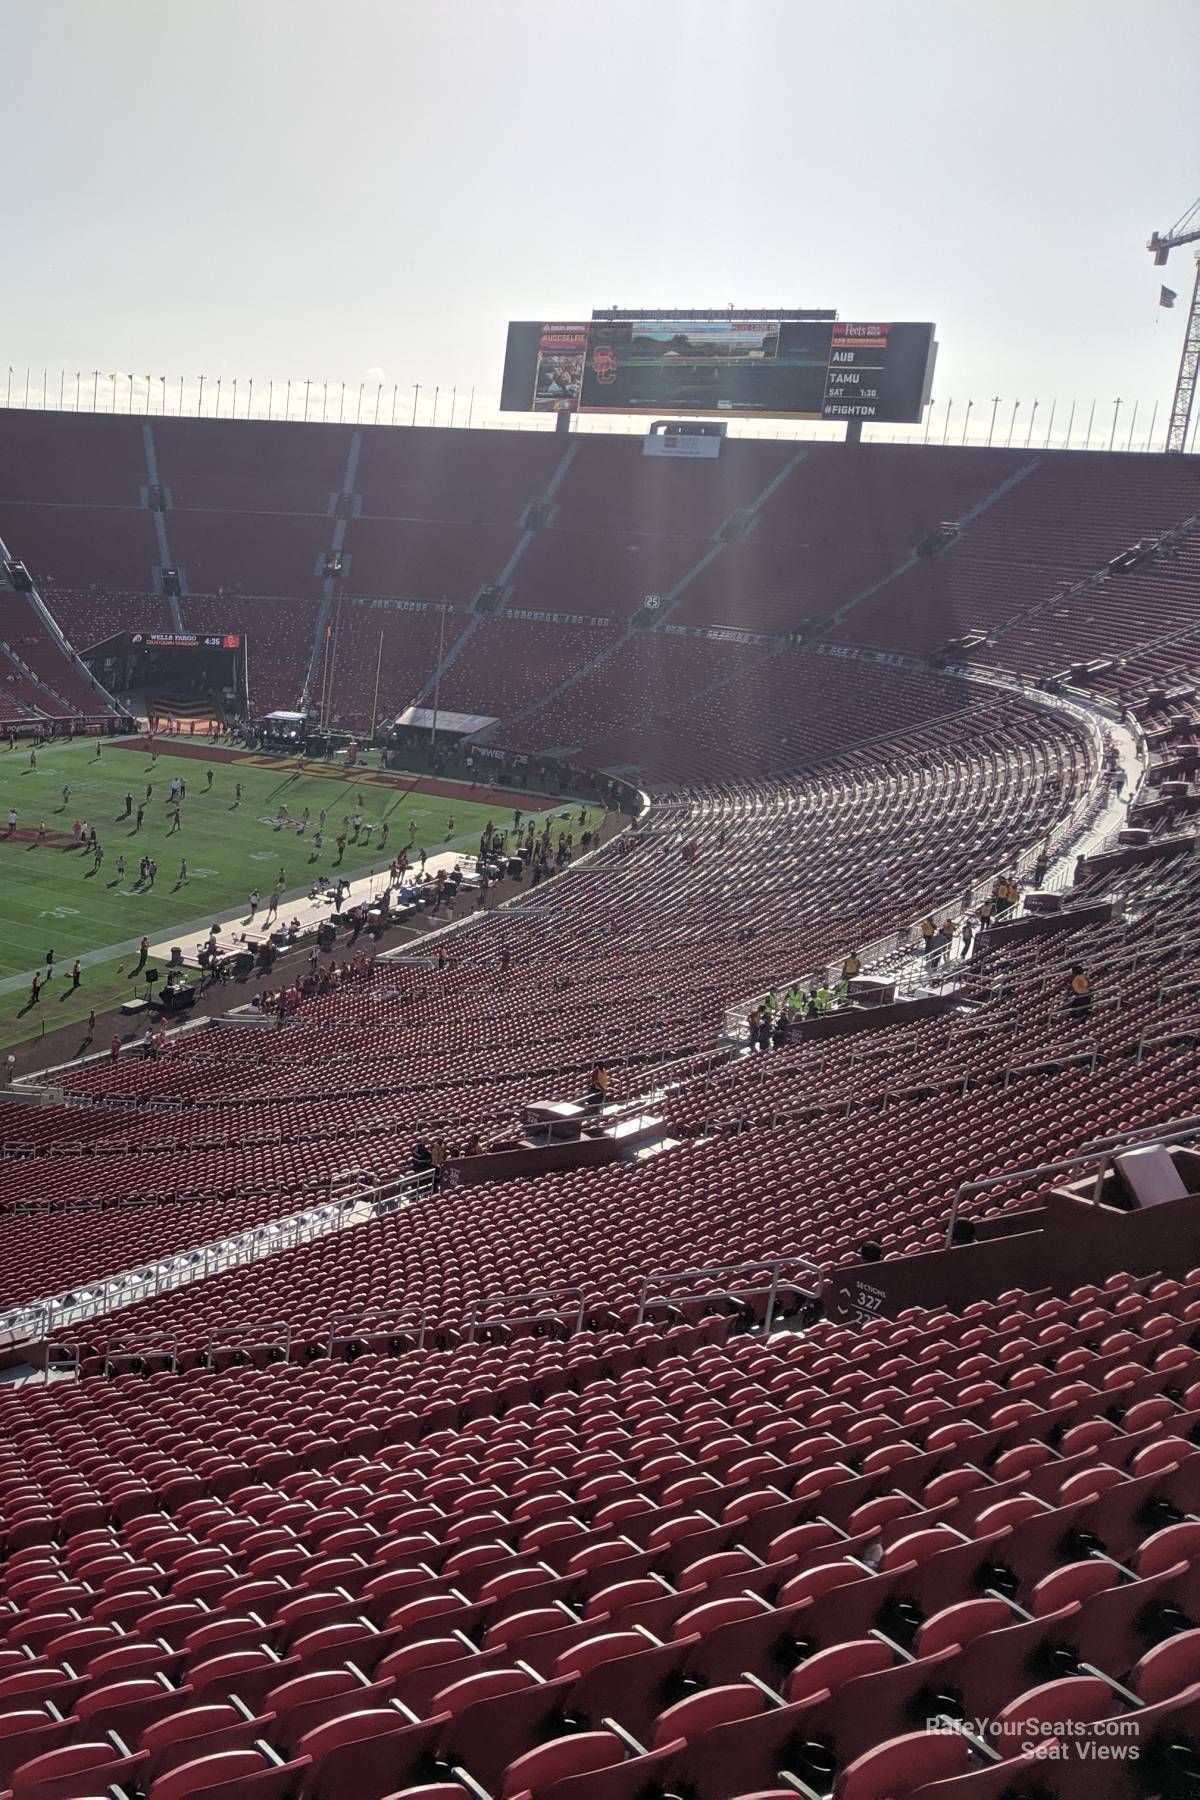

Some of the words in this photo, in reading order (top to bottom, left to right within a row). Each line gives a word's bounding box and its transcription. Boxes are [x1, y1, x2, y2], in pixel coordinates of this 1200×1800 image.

[832, 352, 855, 362] AUB
[829, 373, 860, 384] TAMU
[828, 388, 844, 396] SAT
[860, 389, 877, 397] 1:30
[824, 405, 876, 416] #FIGHTON
[856, 1281, 886, 1298] SECTIONS
[857, 1292, 882, 1310] 327
